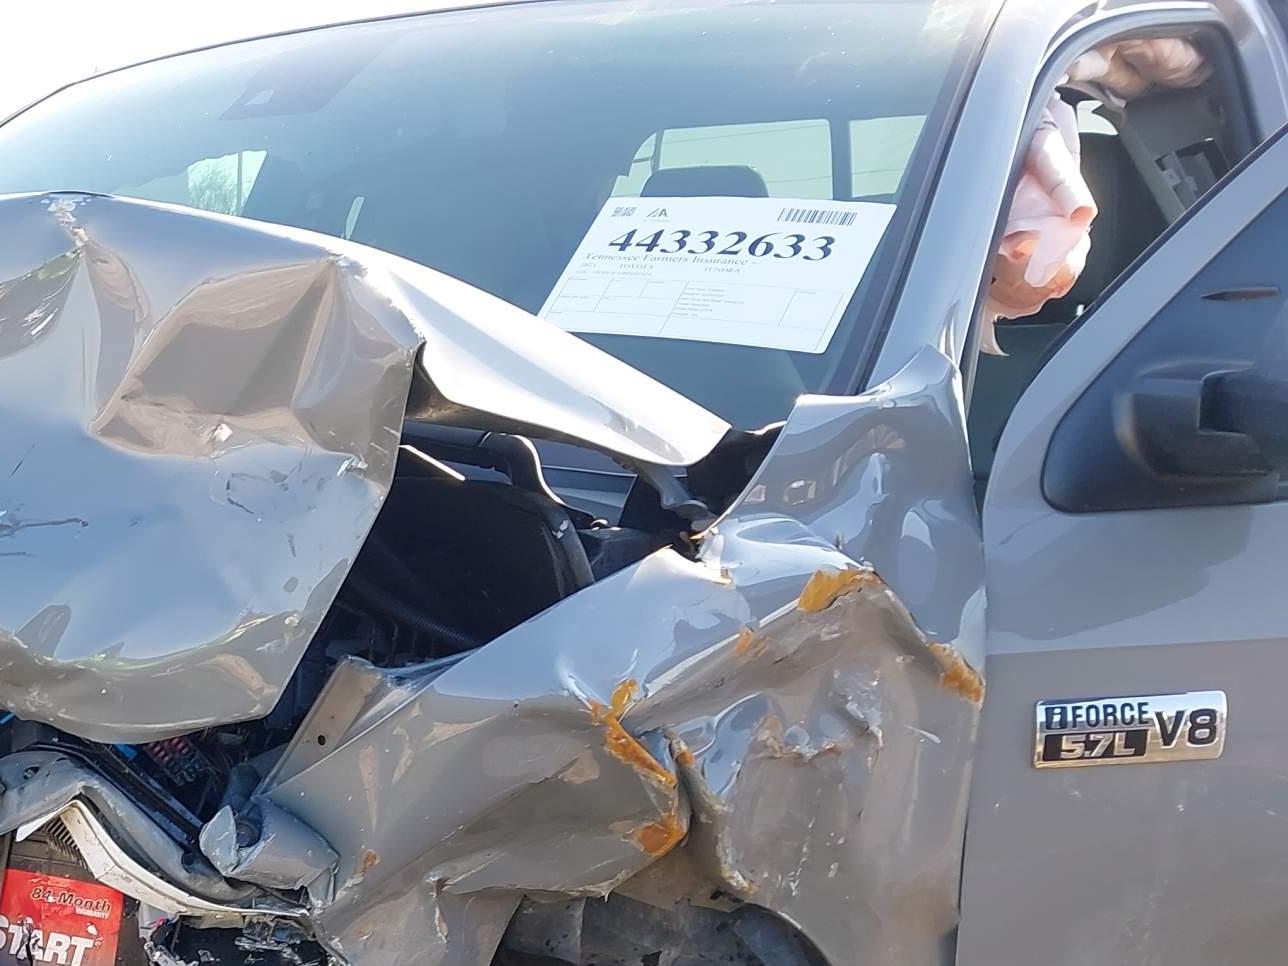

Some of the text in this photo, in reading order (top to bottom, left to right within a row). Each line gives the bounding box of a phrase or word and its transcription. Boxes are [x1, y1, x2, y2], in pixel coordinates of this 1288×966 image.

[585, 252, 641, 262] Tennessee
[642, 253, 689, 264] Farmers
[691, 255, 749, 266] Insurance
[608, 228, 836, 261] 44332633
[1153, 708, 1218, 748] V8
